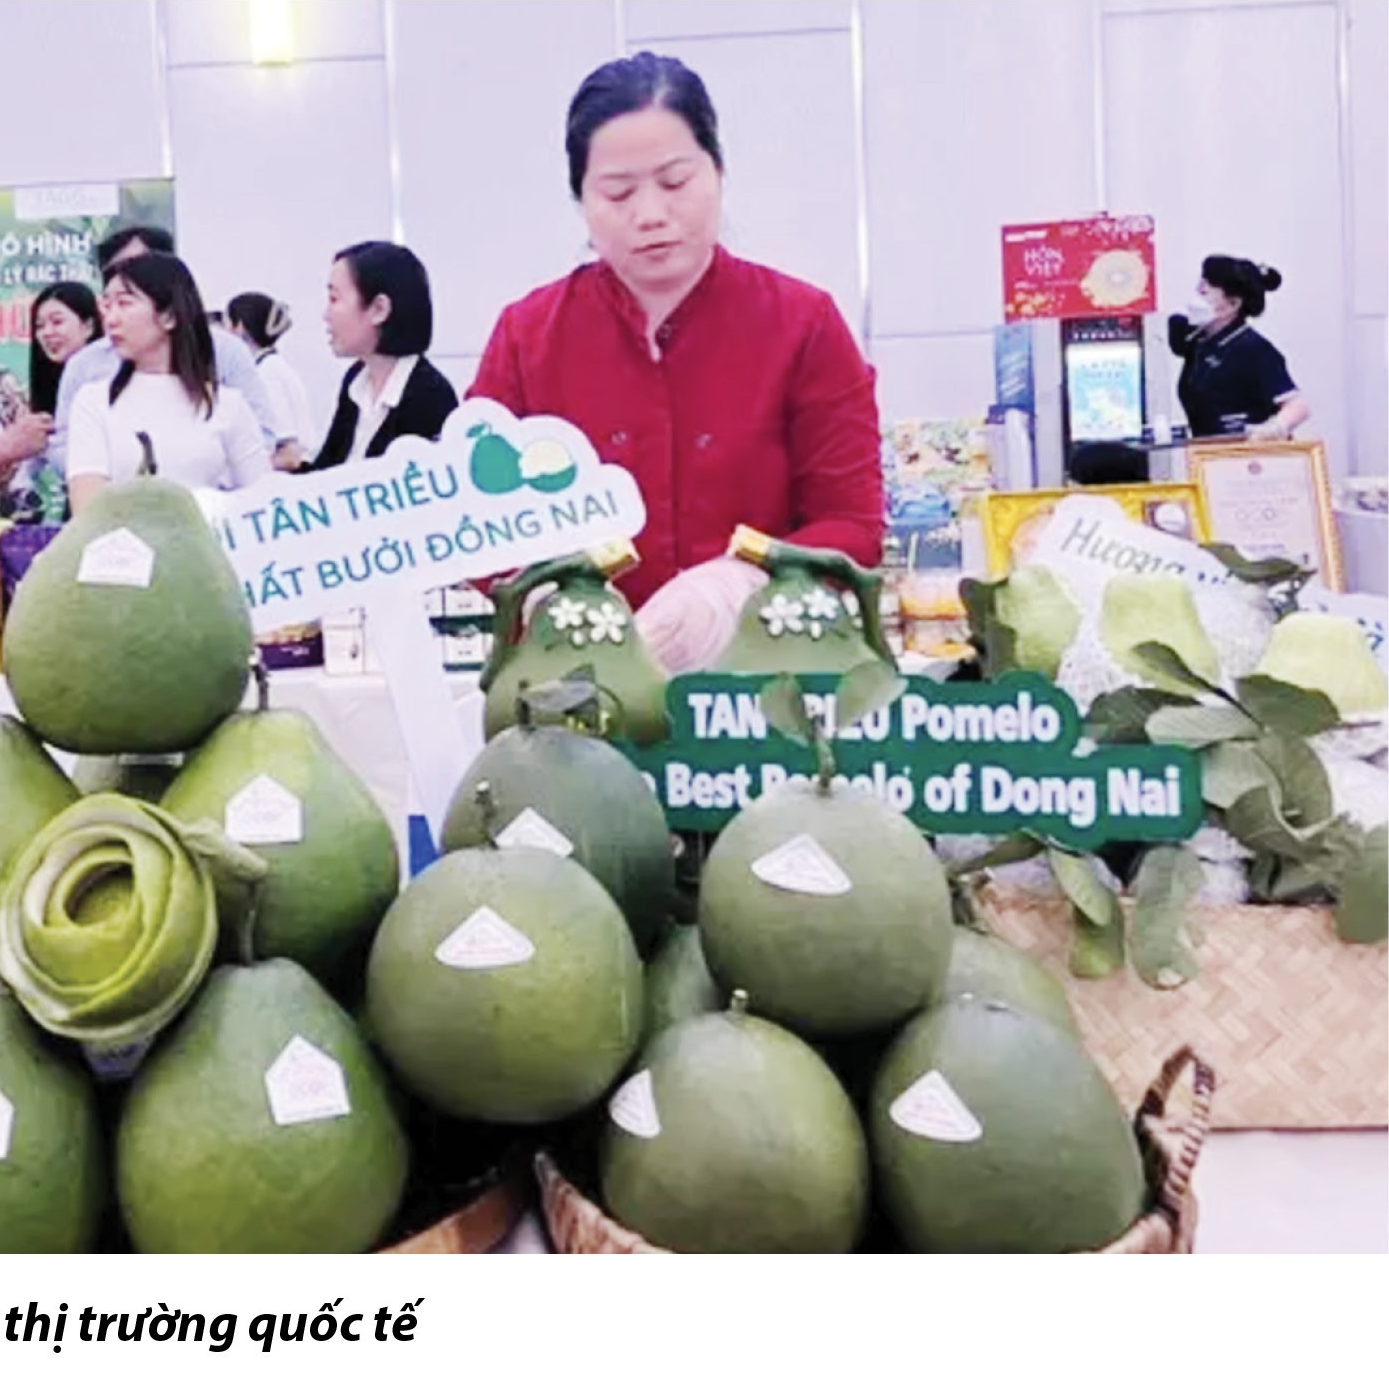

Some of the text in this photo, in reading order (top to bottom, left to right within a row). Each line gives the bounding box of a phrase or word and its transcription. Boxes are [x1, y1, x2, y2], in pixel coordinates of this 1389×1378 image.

[243, 494, 331, 544] TÂN
[336, 461, 460, 521] TRIỀU
[244, 489, 620, 609] ẤT BƯỞI ĐỒNG NAI
[688, 692, 767, 740] TAN
[902, 690, 1061, 743] Pomelo
[664, 761, 752, 809] Best
[924, 761, 972, 810] of
[981, 766, 1097, 828] Dong
[1106, 764, 1182, 817] Nai
